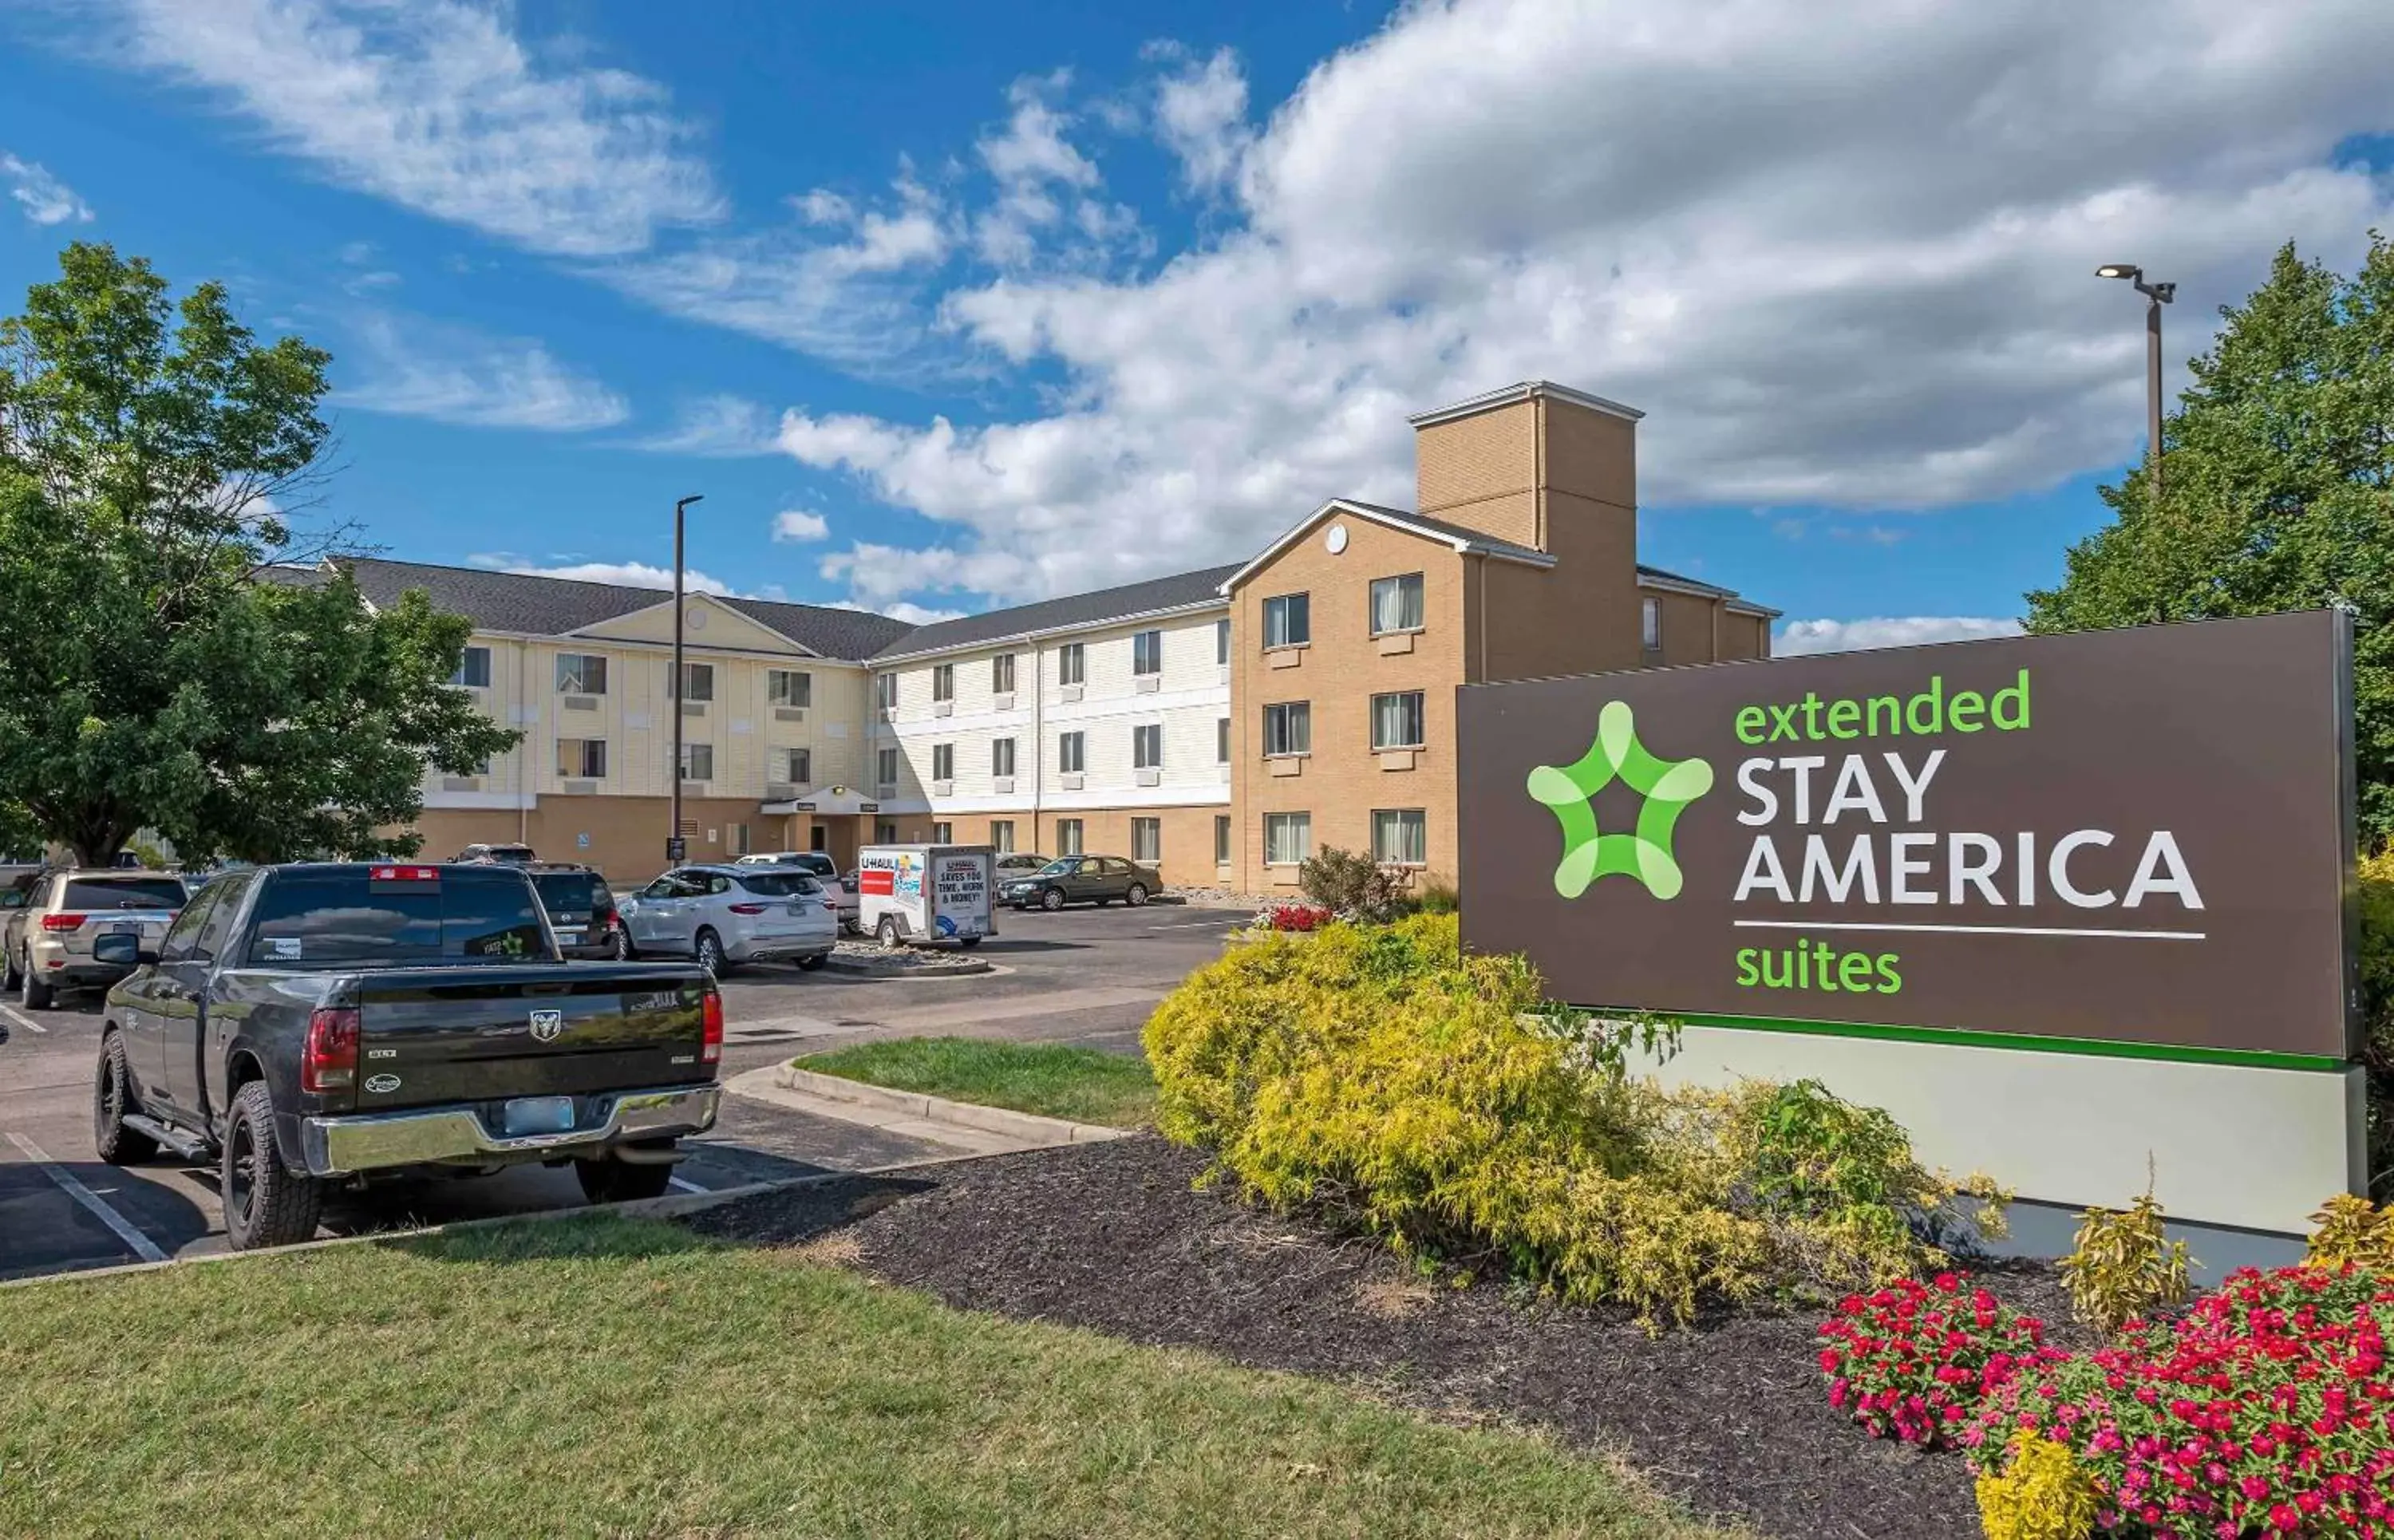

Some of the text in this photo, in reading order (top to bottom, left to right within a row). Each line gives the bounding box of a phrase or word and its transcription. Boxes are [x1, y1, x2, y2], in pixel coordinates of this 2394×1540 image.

[1736, 669, 2031, 745] extended
[1736, 749, 1947, 826] STAY
[861, 857, 895, 869] U-HAUL
[940, 872, 965, 883] SAVES
[962, 882, 984, 892] WORK
[1733, 829, 2206, 910] AMERICA
[1736, 938, 1902, 994] suites
